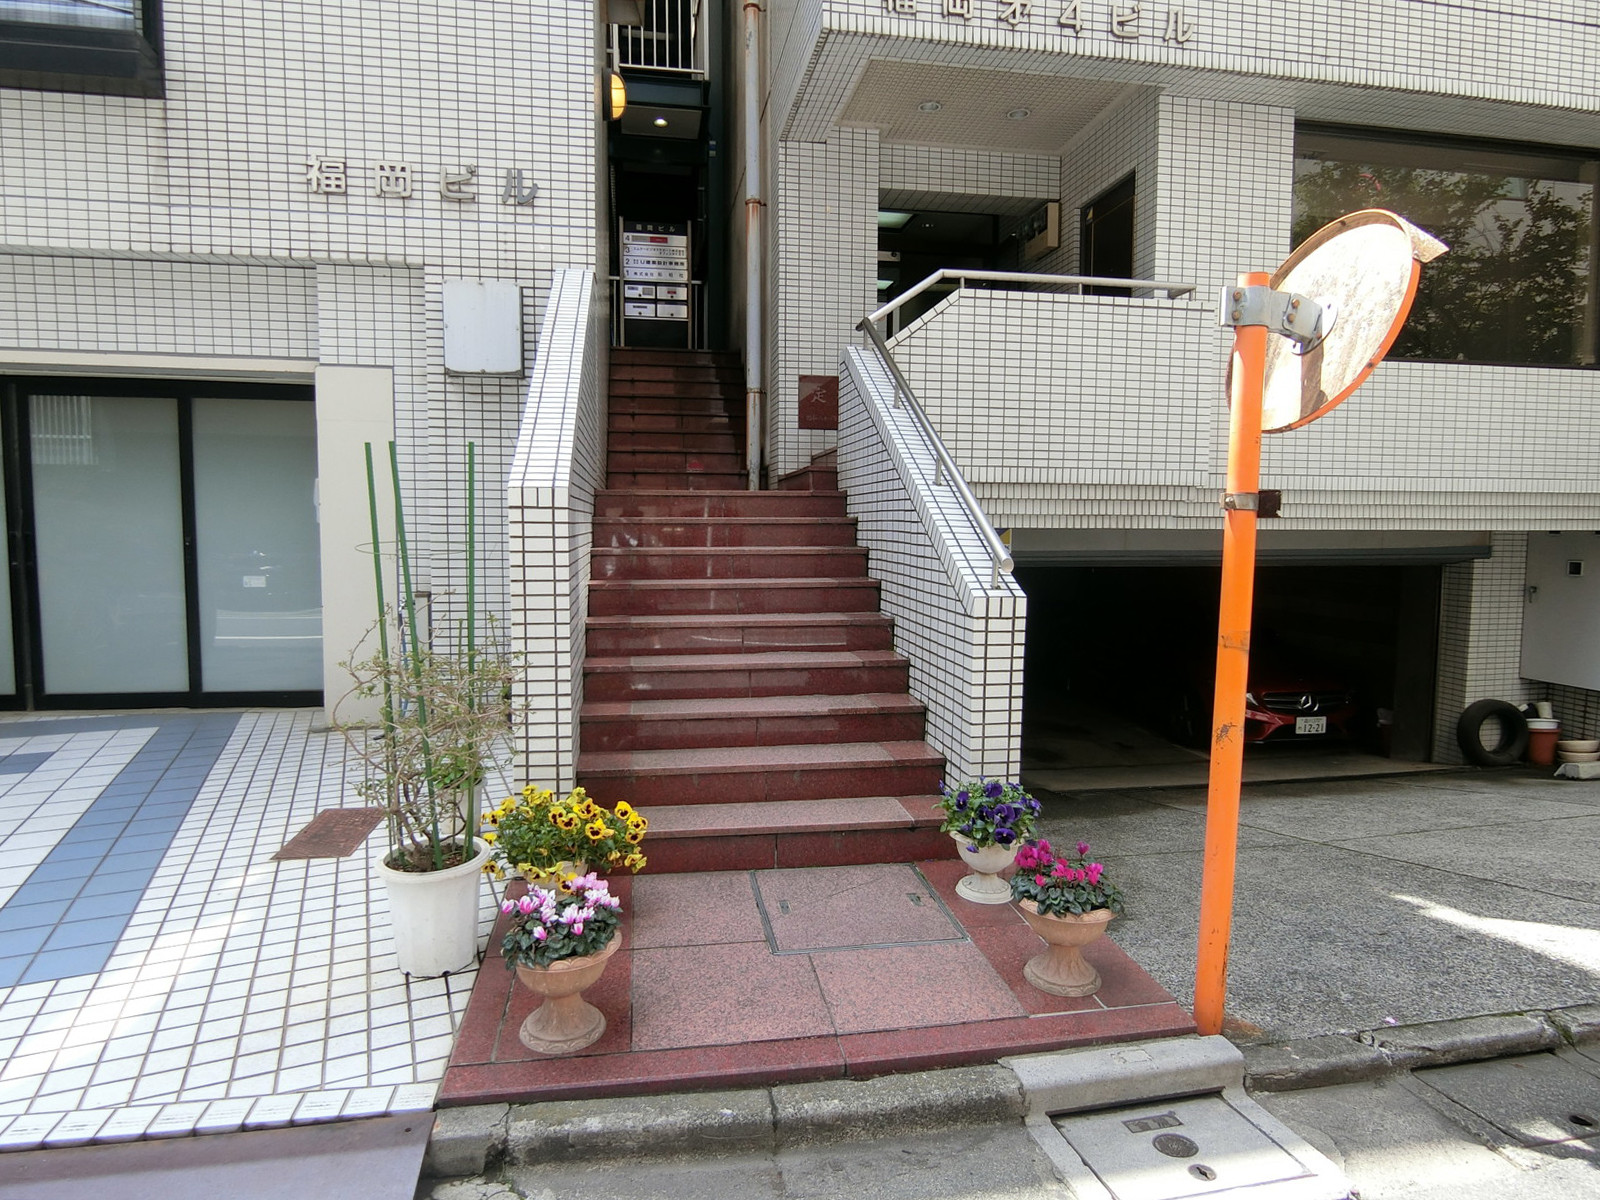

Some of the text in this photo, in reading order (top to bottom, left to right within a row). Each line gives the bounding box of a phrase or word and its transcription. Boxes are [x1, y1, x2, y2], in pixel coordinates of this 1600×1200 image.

[306, 154, 537, 205] 福岡ビル
[1303, 723, 1324, 732] 12-21
